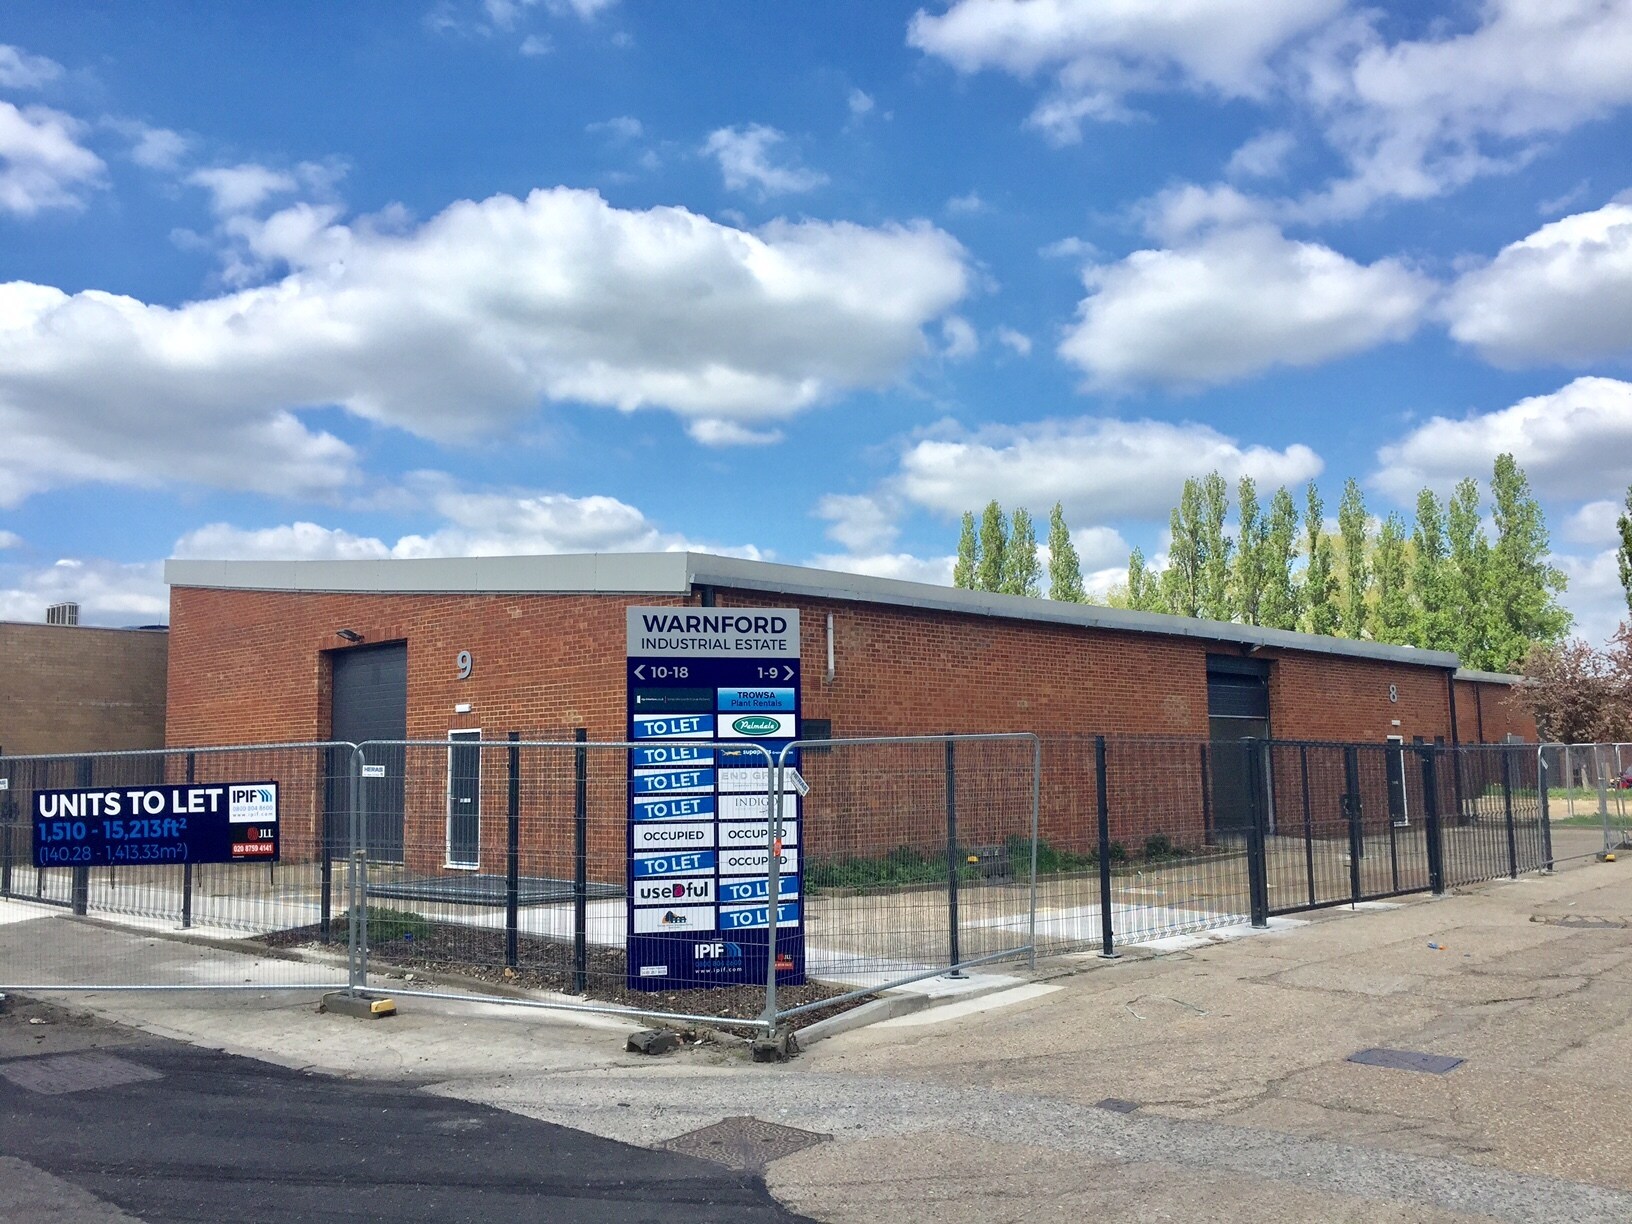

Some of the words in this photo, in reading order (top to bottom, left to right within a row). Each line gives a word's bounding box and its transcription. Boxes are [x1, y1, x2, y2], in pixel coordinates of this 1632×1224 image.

[642, 614, 788, 634] WARNFORD
[641, 638, 731, 650] INDUSTRIAL
[735, 639, 787, 650] ESTATE
[457, 650, 472, 680] 9
[650, 666, 689, 679] 10-18
[757, 667, 779, 679] 1-9
[737, 691, 776, 699] TROWSA
[1389, 684, 1398, 703] 8
[731, 699, 751, 707] Plant
[753, 699, 783, 707] Rentals
[644, 721, 667, 735] TO
[670, 717, 700, 733] LET
[644, 748, 667, 762] TO
[644, 776, 668, 790] TO
[671, 772, 700, 787] LET
[721, 771, 748, 780] END
[39, 792, 121, 818] UNITS
[127, 790, 165, 815] TO
[172, 788, 223, 813] LET
[232, 789, 257, 804] IPIF
[644, 803, 668, 818] TO
[671, 799, 701, 815] LET
[38, 822, 86, 843] 1,510
[259, 828, 273, 838] JLL
[643, 830, 705, 841] OCCUPIED
[39, 846, 91, 864] (140.28
[233, 845, 244, 853] 020
[245, 844, 258, 852] 8759
[260, 844, 272, 852] 4141
[644, 859, 668, 874] TO
[671, 854, 701, 871] LET
[728, 856, 788, 866] OCCUPD
[730, 884, 752, 899] TO
[730, 911, 753, 927] TO
[694, 943, 725, 959] IPIF
